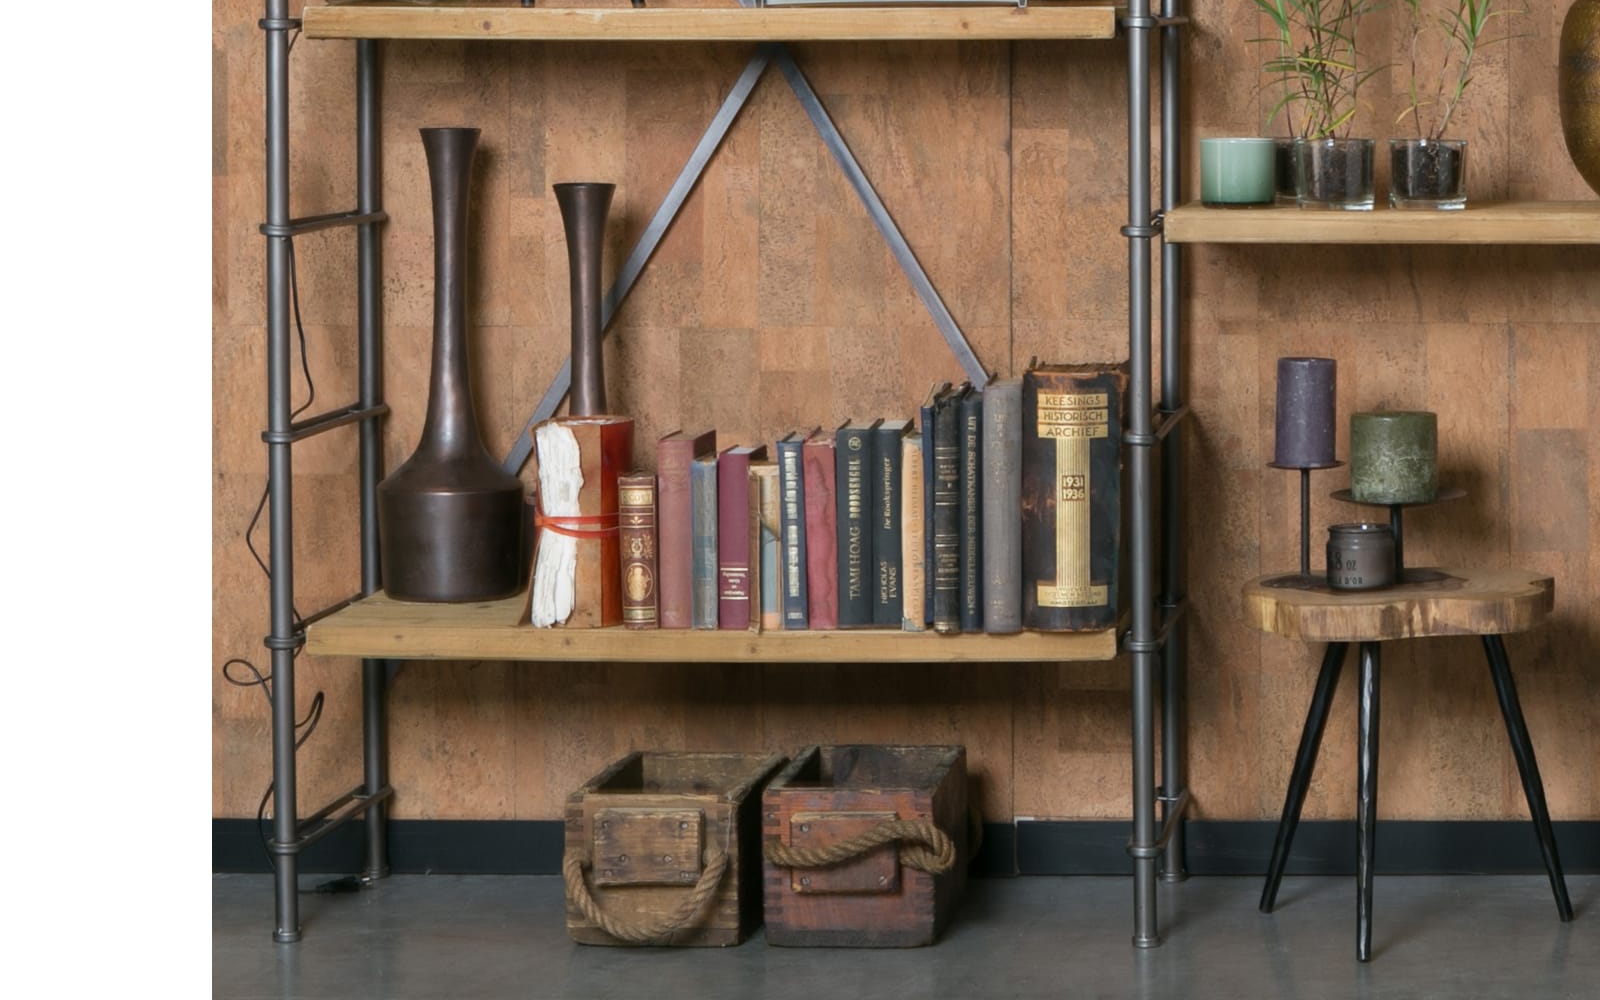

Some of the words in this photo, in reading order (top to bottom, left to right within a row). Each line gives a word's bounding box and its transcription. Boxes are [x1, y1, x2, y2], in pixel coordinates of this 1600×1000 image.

[1045, 396, 1100, 406] KEESINGS
[967, 416, 977, 431] UIT
[1043, 411, 1103, 421] HISTORISCH
[1046, 426, 1100, 437] ARCHIEF
[967, 435, 977, 448] DE
[849, 459, 861, 519] DOODSENGEL
[883, 457, 893, 517] Rookspringer
[967, 451, 977, 513] SCHATKAMER
[1063, 476, 1084, 487] 1931
[1063, 489, 1084, 500] 1936
[883, 518, 892, 530] De
[967, 515, 977, 533] DER
[849, 526, 860, 564] HOAG
[849, 567, 860, 600] TAMI
[879, 561, 888, 604] NICHOLAS
[888, 567, 897, 598] EVANS
